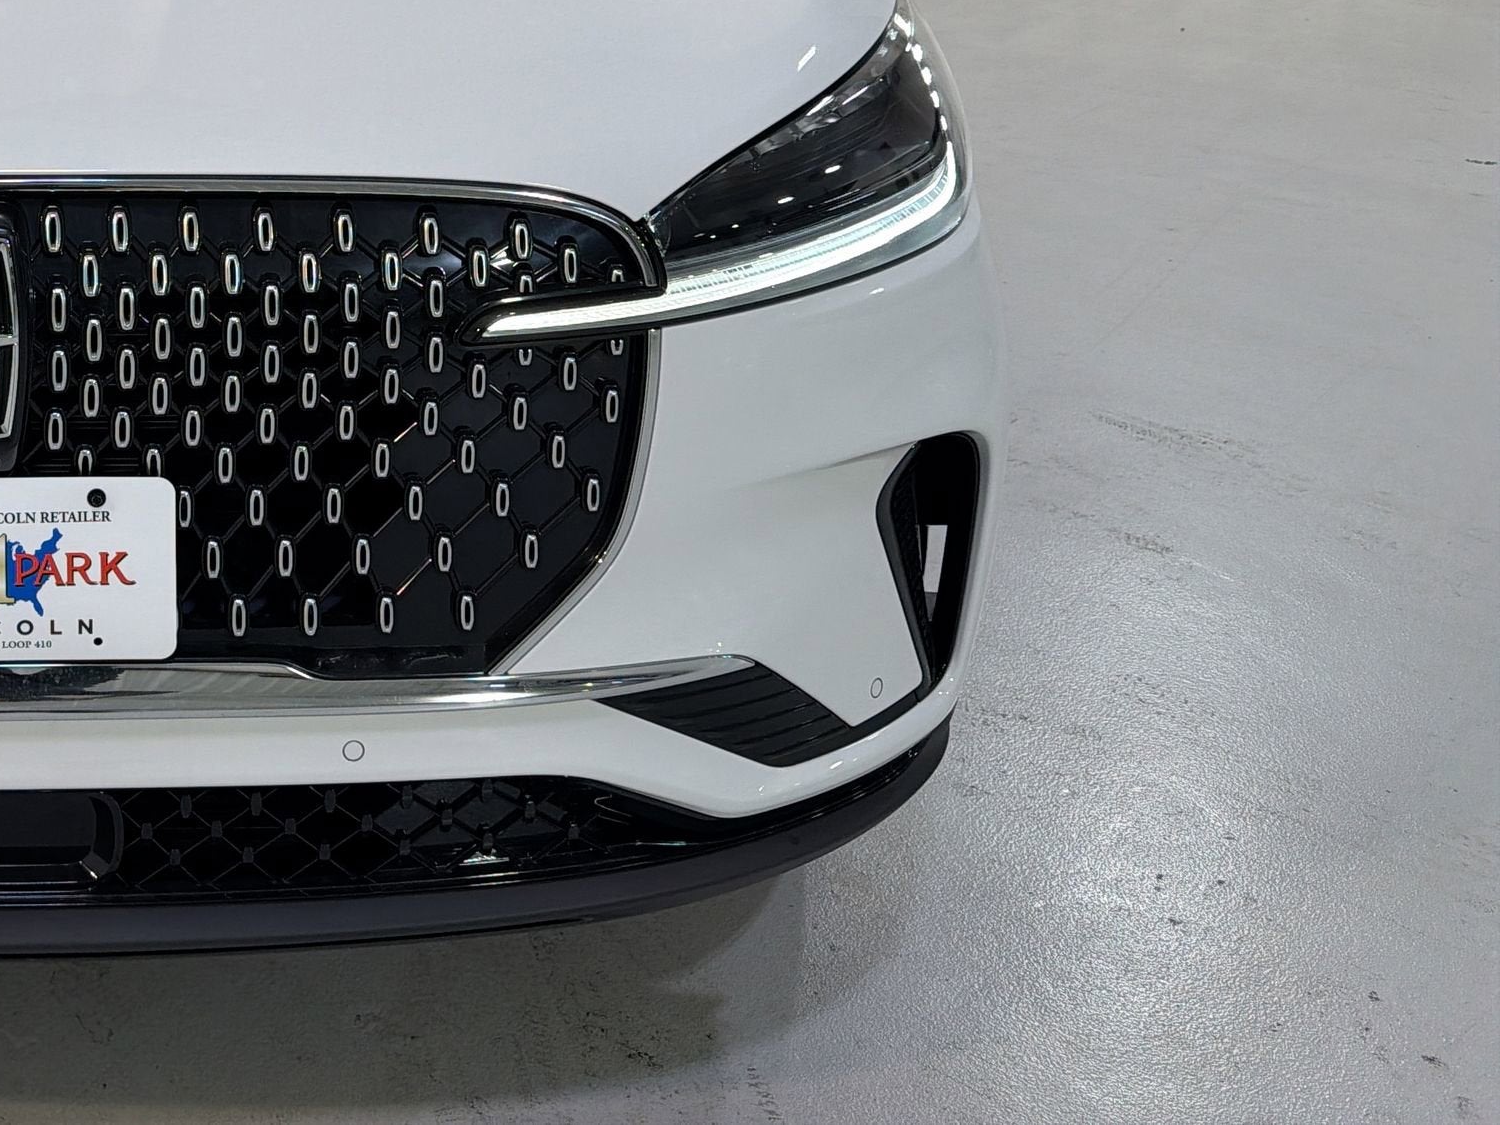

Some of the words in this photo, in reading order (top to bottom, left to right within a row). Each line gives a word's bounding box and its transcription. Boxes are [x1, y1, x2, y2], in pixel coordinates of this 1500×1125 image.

[39, 510, 112, 524] RETAILER
[13, 551, 137, 588] PARK
[2, 640, 32, 649] LOOP
[34, 640, 52, 649] 410
